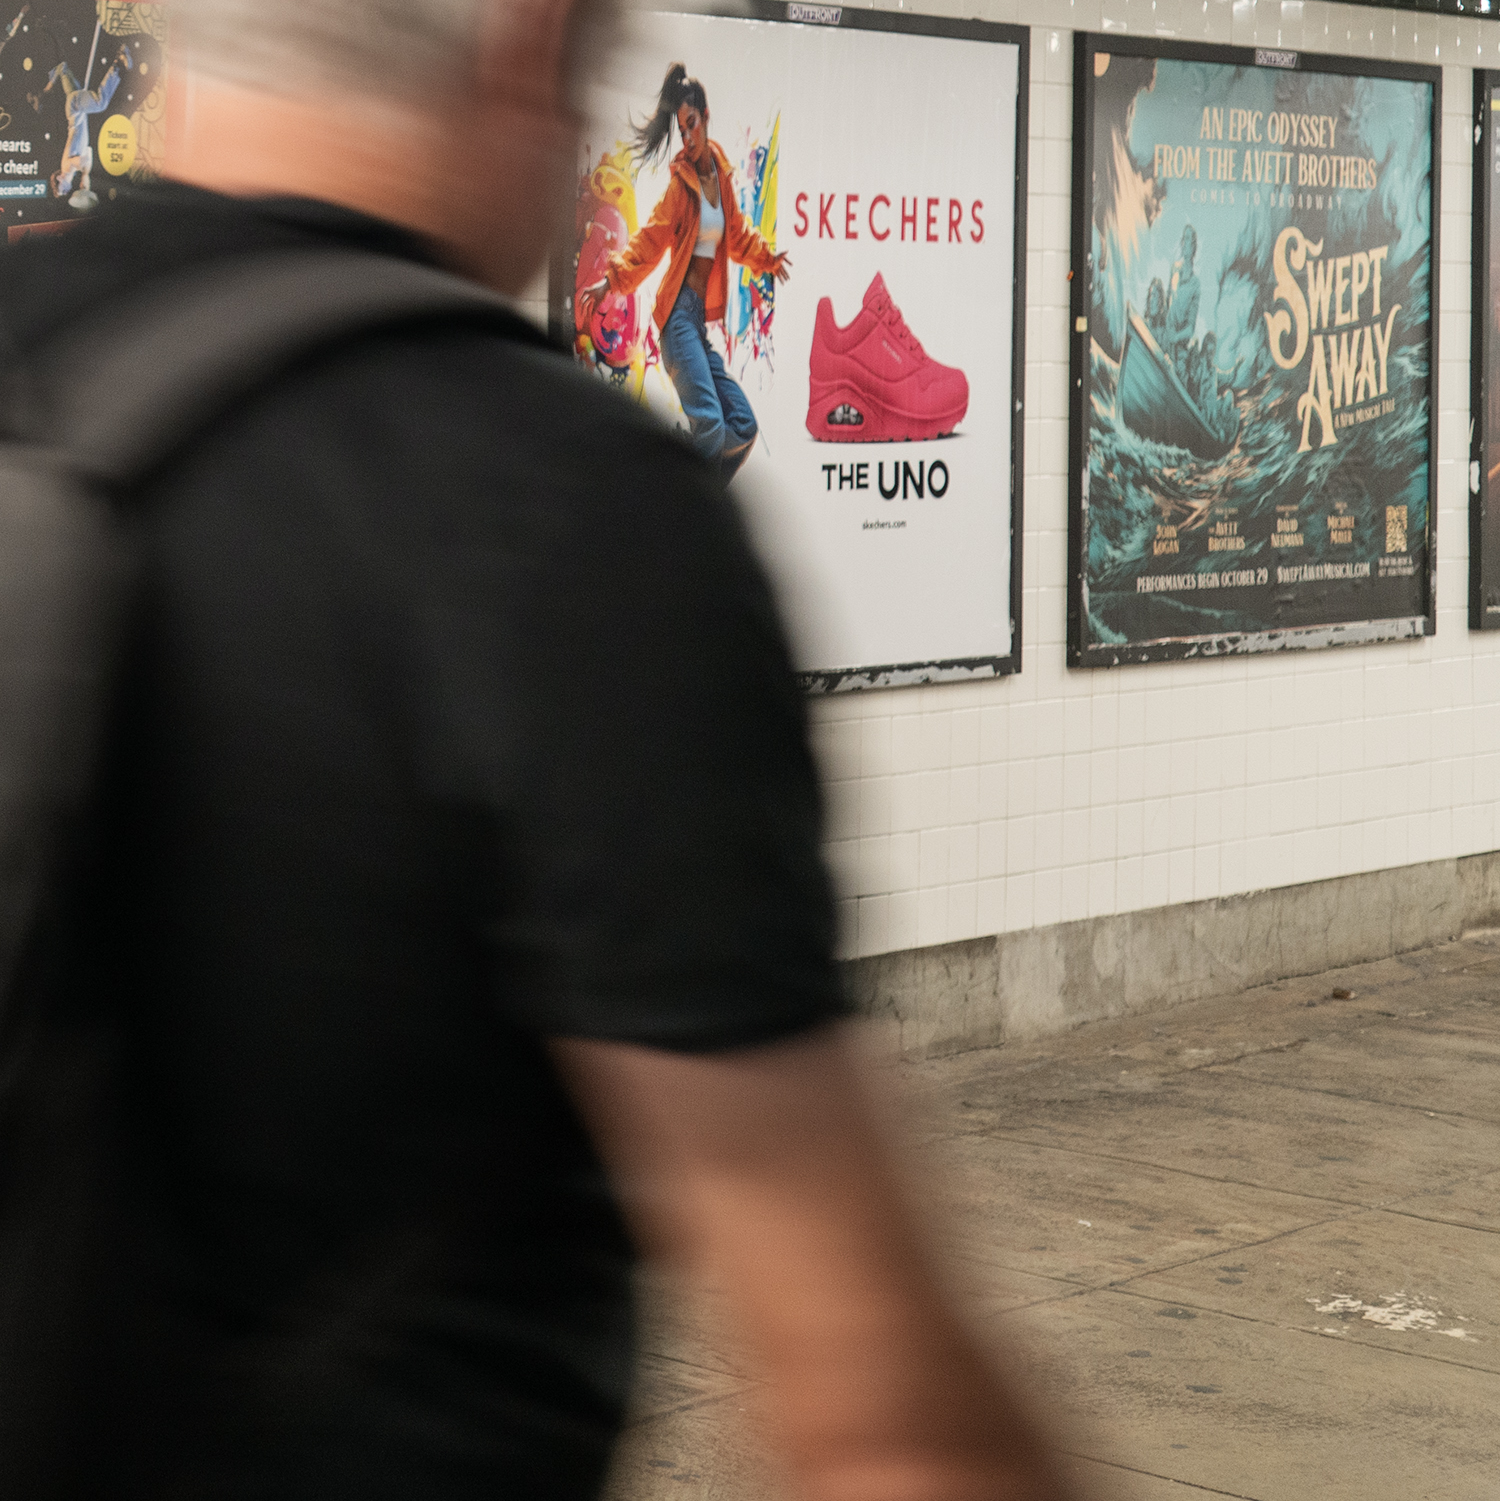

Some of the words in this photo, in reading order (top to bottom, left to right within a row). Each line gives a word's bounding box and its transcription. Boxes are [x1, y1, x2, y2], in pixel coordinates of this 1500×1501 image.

[1200, 106, 1223, 140] AN
[1229, 108, 1262, 142] EPIC
[1267, 111, 1338, 149] ODYSSEY
[4, 159, 38, 175] cheer!
[1154, 145, 1200, 179] FROM
[1206, 148, 1237, 181] THE
[1242, 150, 1294, 185] AVETT
[1298, 153, 1376, 189] BROTHERS
[35, 184, 45, 195] 29
[794, 191, 985, 243] SKECHERS
[1297, 303, 1402, 453] AWAY
[822, 463, 869, 491] THE
[878, 460, 949, 500] UNO
[862, 520, 906, 530] skechers.com
[1137, 573, 1196, 593] PERFORMANCES
[1198, 572, 1219, 589] BEGIN
[1221, 569, 1255, 587] OCTOBER
[1257, 567, 1268, 585] 29
